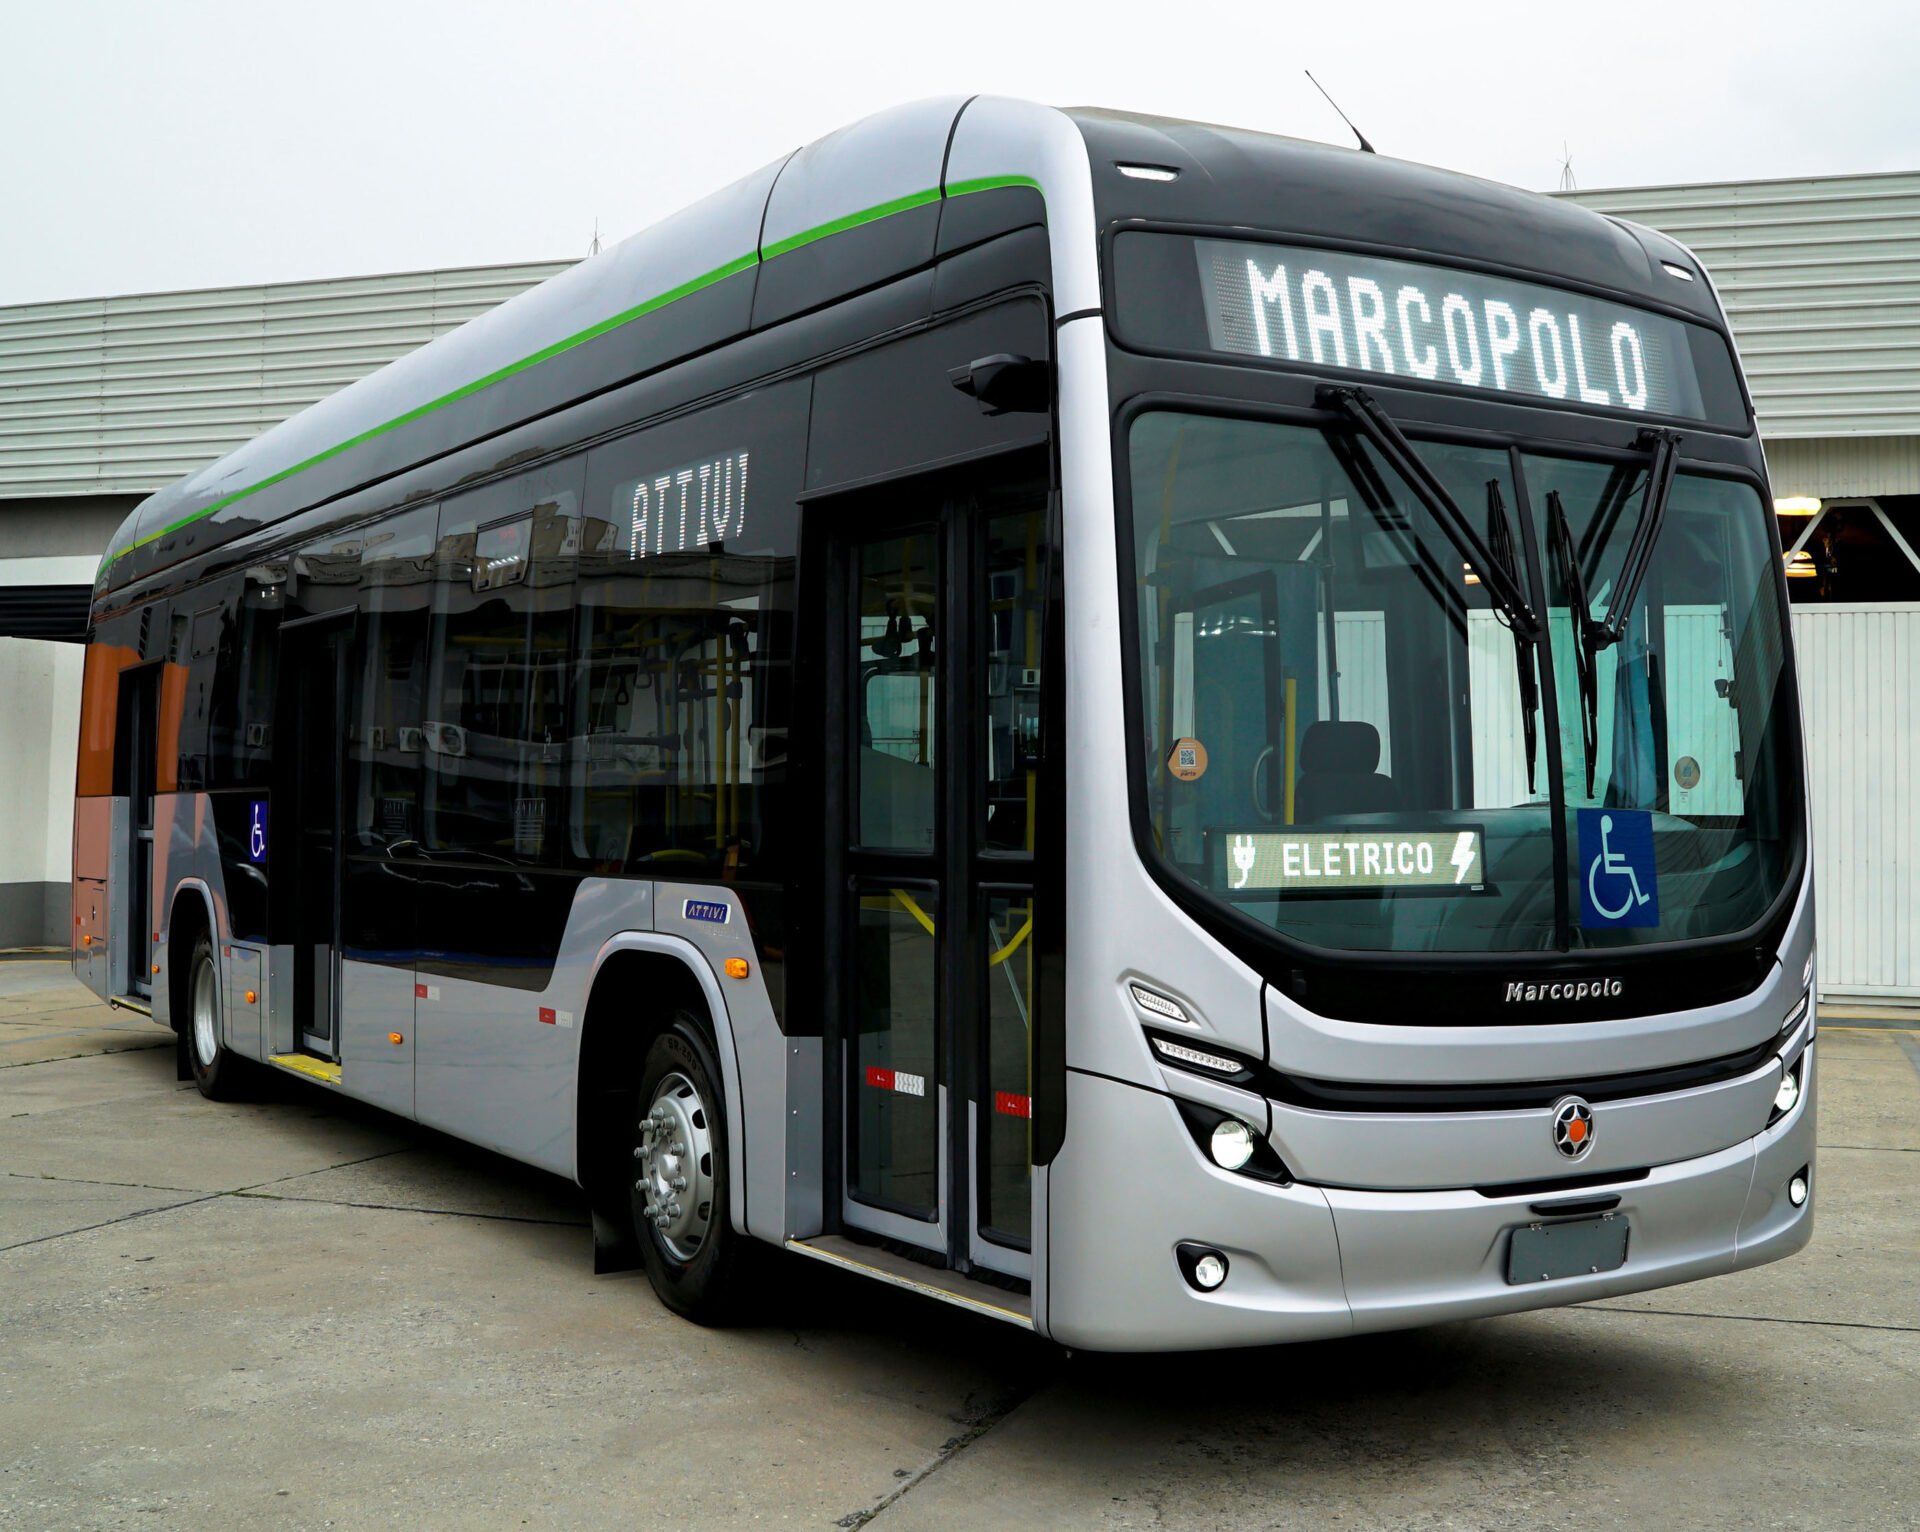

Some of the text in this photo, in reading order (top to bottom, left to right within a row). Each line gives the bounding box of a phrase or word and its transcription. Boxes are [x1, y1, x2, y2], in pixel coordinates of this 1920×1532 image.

[1246, 258, 1648, 411] MARCOPOLO
[630, 453, 749, 560] ATTIVI
[1283, 842, 1434, 876] ELETRICO
[1505, 978, 1623, 1002] Marcopolo
